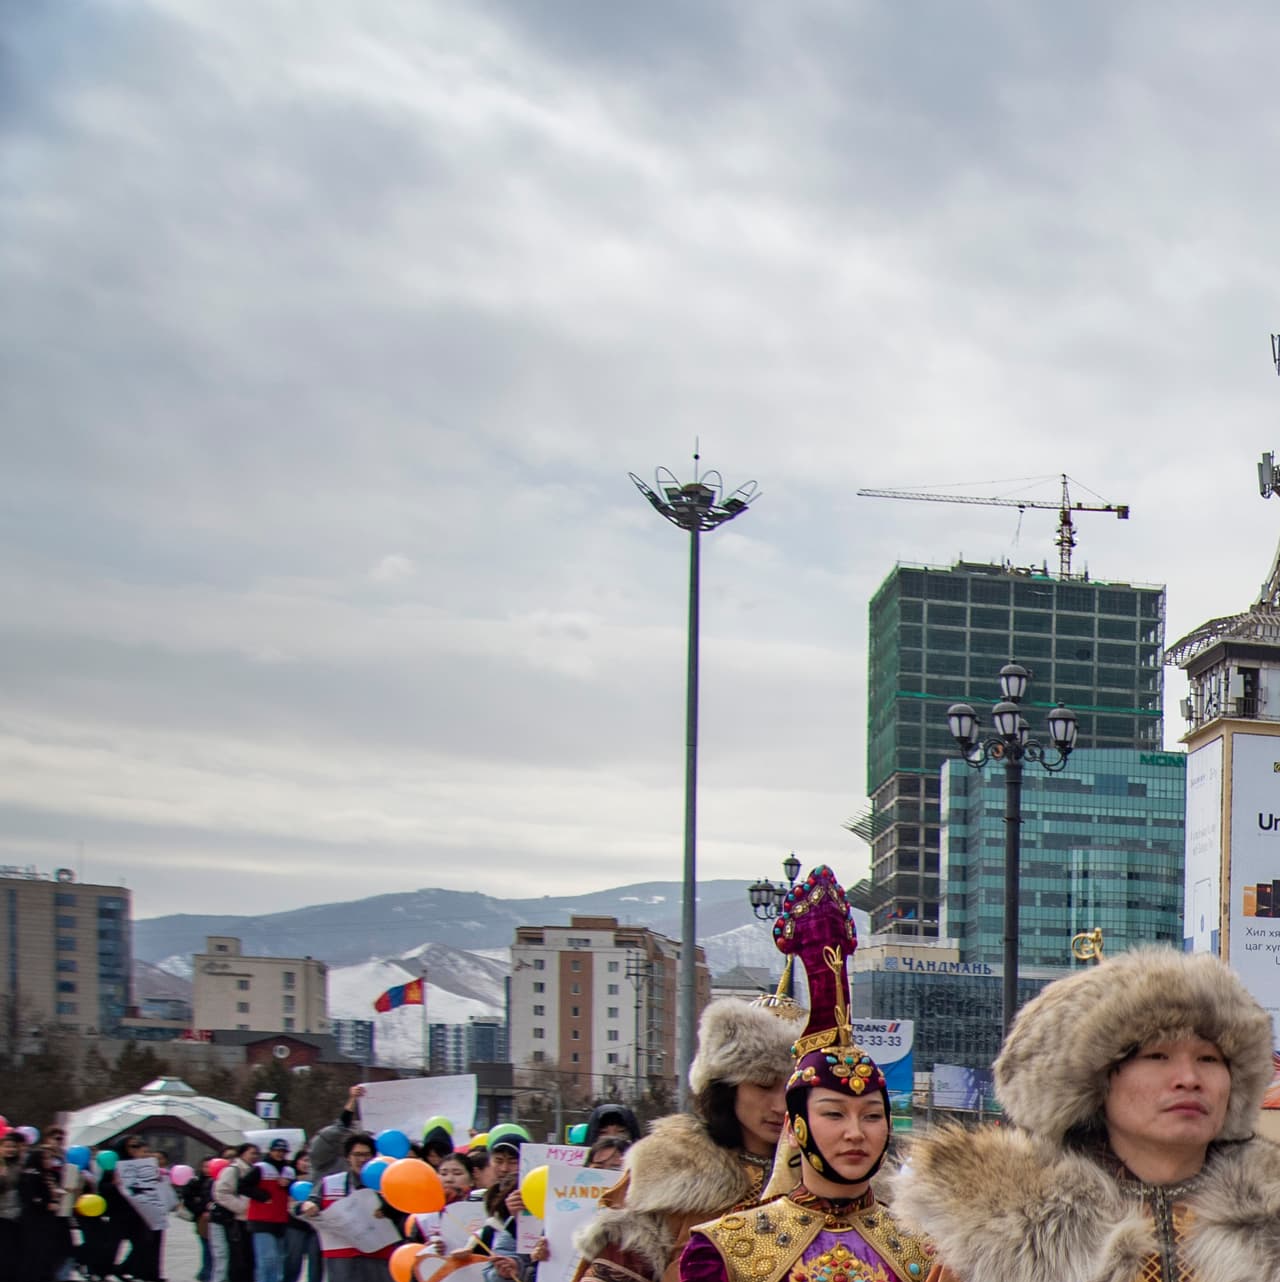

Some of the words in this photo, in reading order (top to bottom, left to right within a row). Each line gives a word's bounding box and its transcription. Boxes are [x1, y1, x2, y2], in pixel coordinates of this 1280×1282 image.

[1245, 927, 1266, 937] Хил
[1245, 943, 1263, 953] цаг
[901, 957, 992, 975] ЧАНДМАНЬ
